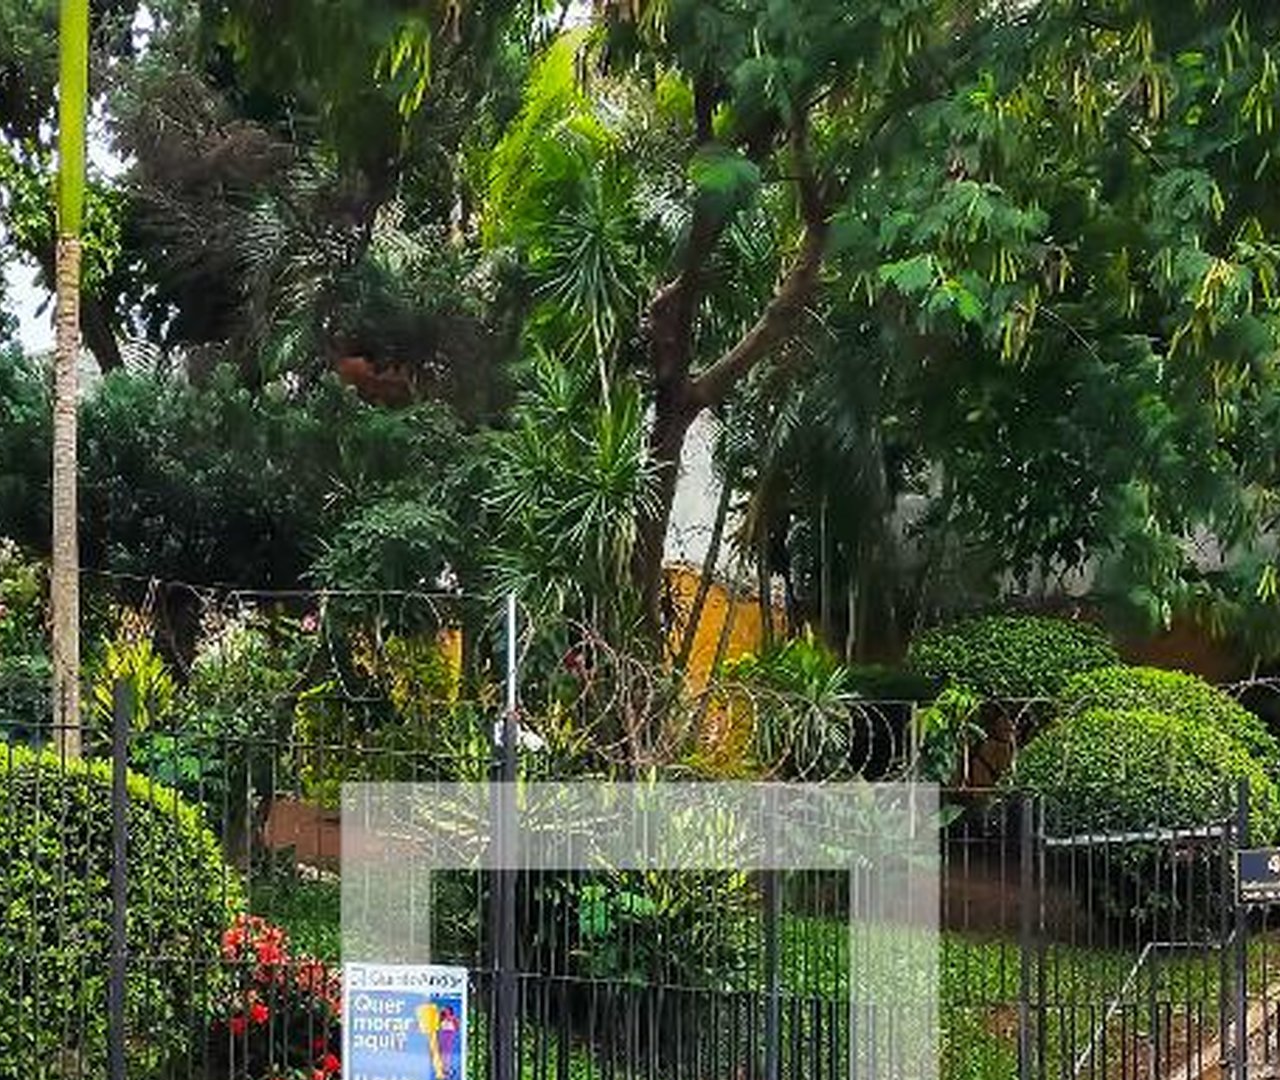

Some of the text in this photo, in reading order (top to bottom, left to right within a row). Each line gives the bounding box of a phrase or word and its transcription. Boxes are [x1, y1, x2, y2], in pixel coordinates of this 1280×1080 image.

[353, 994, 406, 1015] Quer
[353, 1016, 415, 1032] morar
[353, 1032, 407, 1051] aqui?
